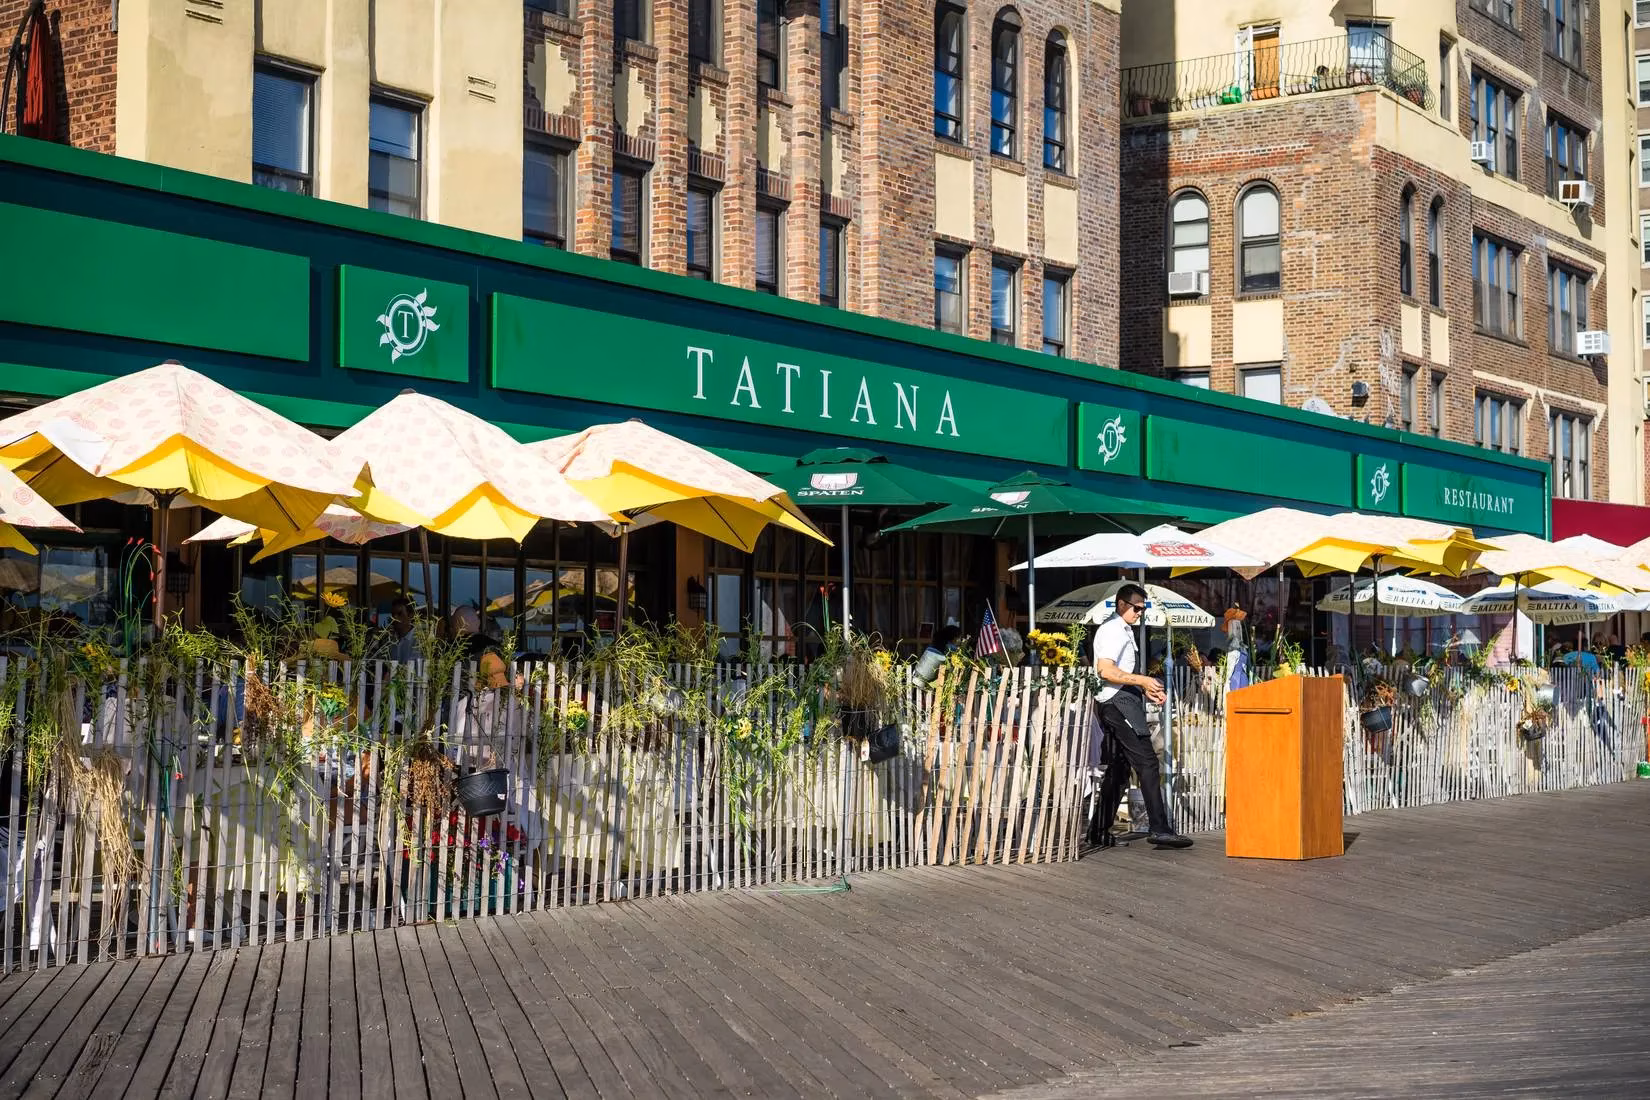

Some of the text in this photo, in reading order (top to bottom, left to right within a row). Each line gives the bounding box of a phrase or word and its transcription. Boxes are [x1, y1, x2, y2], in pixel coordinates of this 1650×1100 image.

[687, 346, 960, 436] TATIANA
[1444, 487, 1514, 514] RESTAURANT
[1393, 595, 1433, 605] BALTIKA
[1477, 603, 1514, 613] BALTIKA
[1536, 602, 1578, 611] BALTIKA
[1050, 611, 1087, 621] BALTIKA
[1176, 614, 1208, 623] BALTIKA
